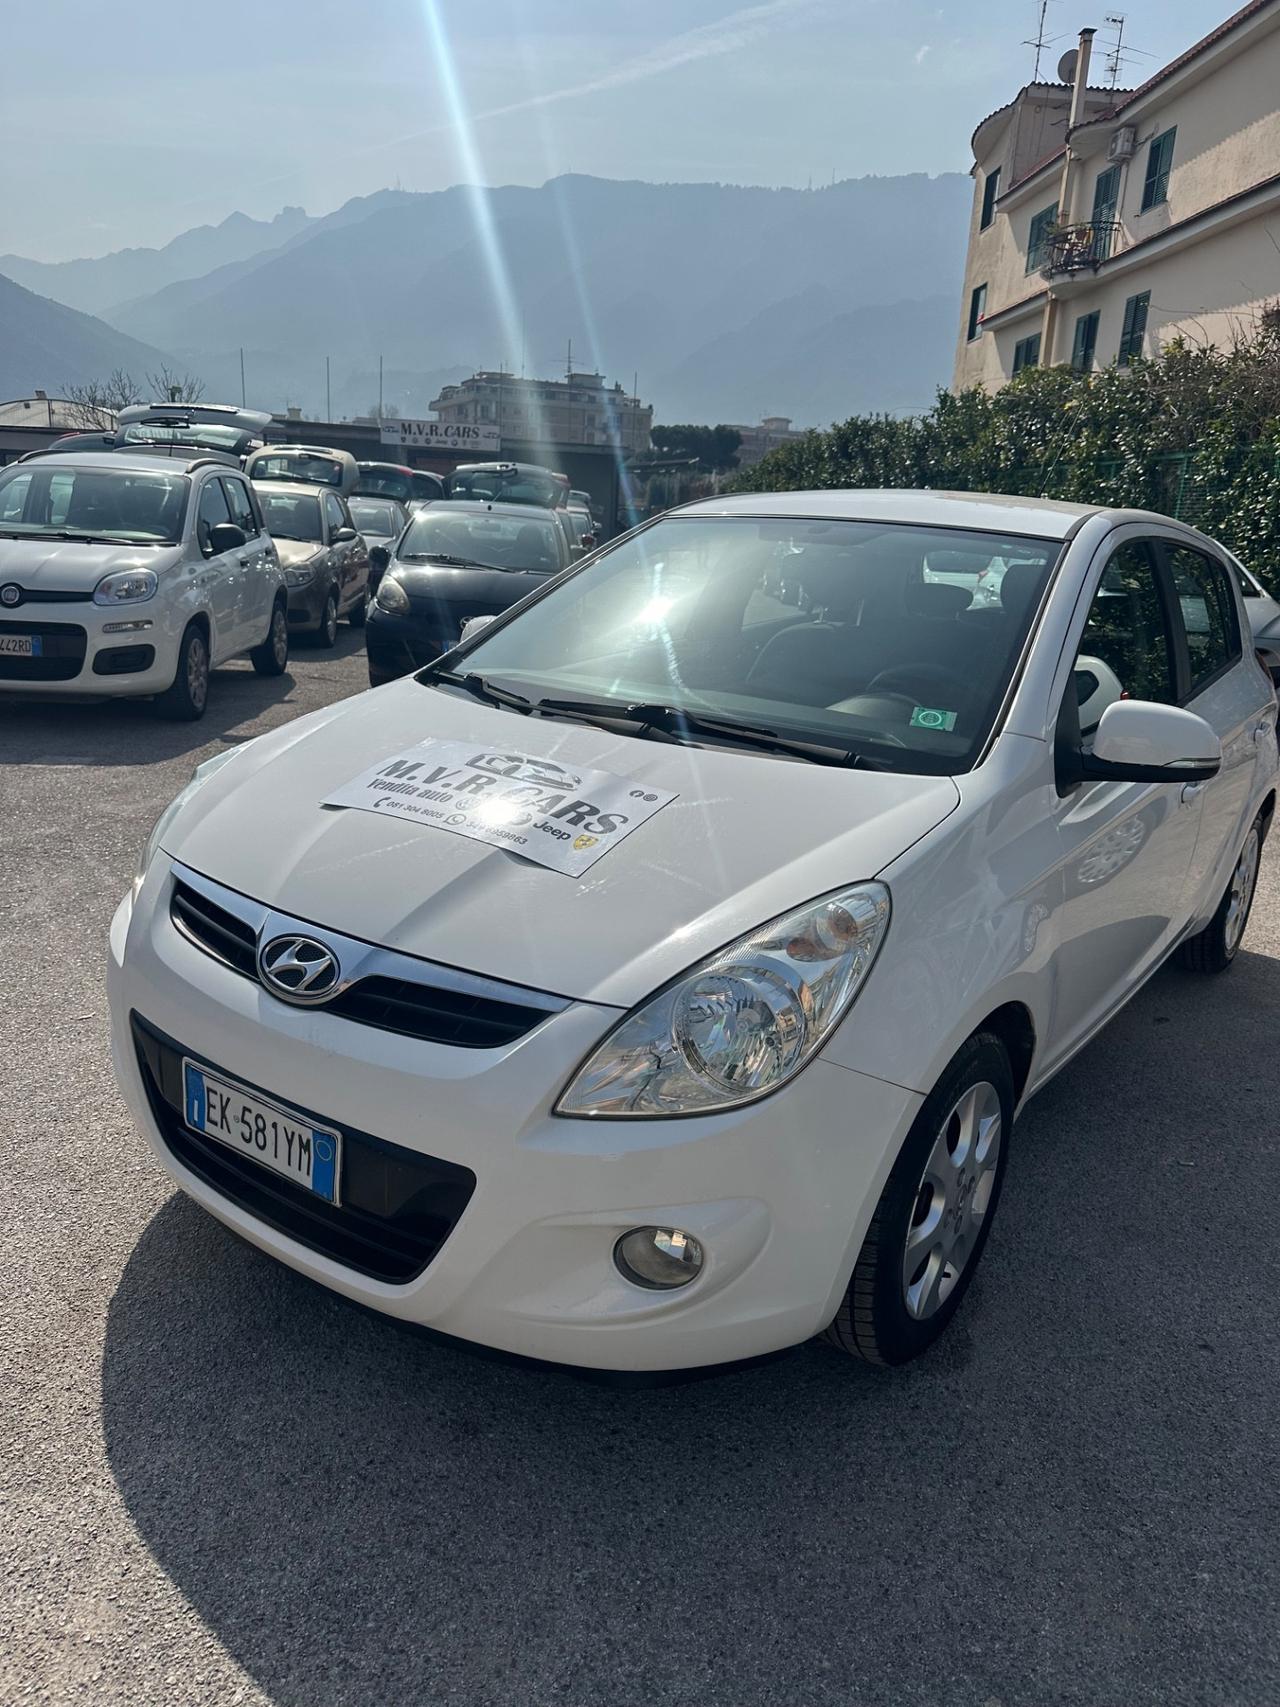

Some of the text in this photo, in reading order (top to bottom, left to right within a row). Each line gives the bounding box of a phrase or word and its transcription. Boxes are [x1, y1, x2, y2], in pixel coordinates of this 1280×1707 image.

[367, 778, 453, 803] Vendita auto
[533, 821, 572, 841] Jeep
